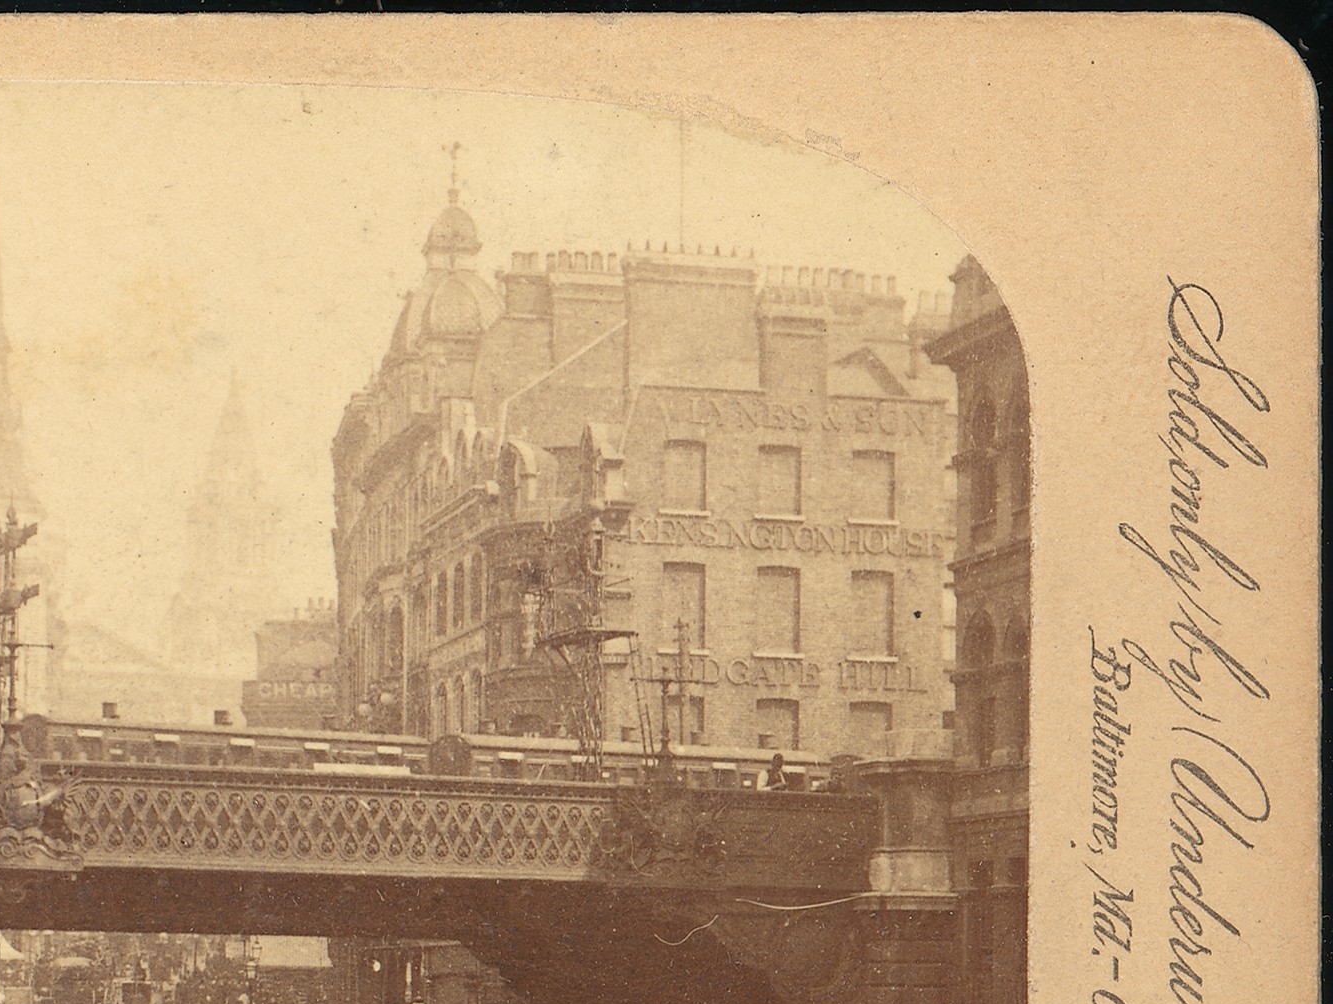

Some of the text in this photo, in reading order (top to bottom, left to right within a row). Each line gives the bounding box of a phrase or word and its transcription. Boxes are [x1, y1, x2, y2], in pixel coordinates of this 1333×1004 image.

[1161, 275, 1271, 468] Sold
[626, 515, 946, 558] KENSINGTON HOUSE
[1119, 452, 1260, 625] only
[258, 682, 333, 699] CHEAP
[837, 660, 929, 694] HILL
[1122, 609, 1270, 722] by
[1086, 625, 1133, 858] Baltimore,
